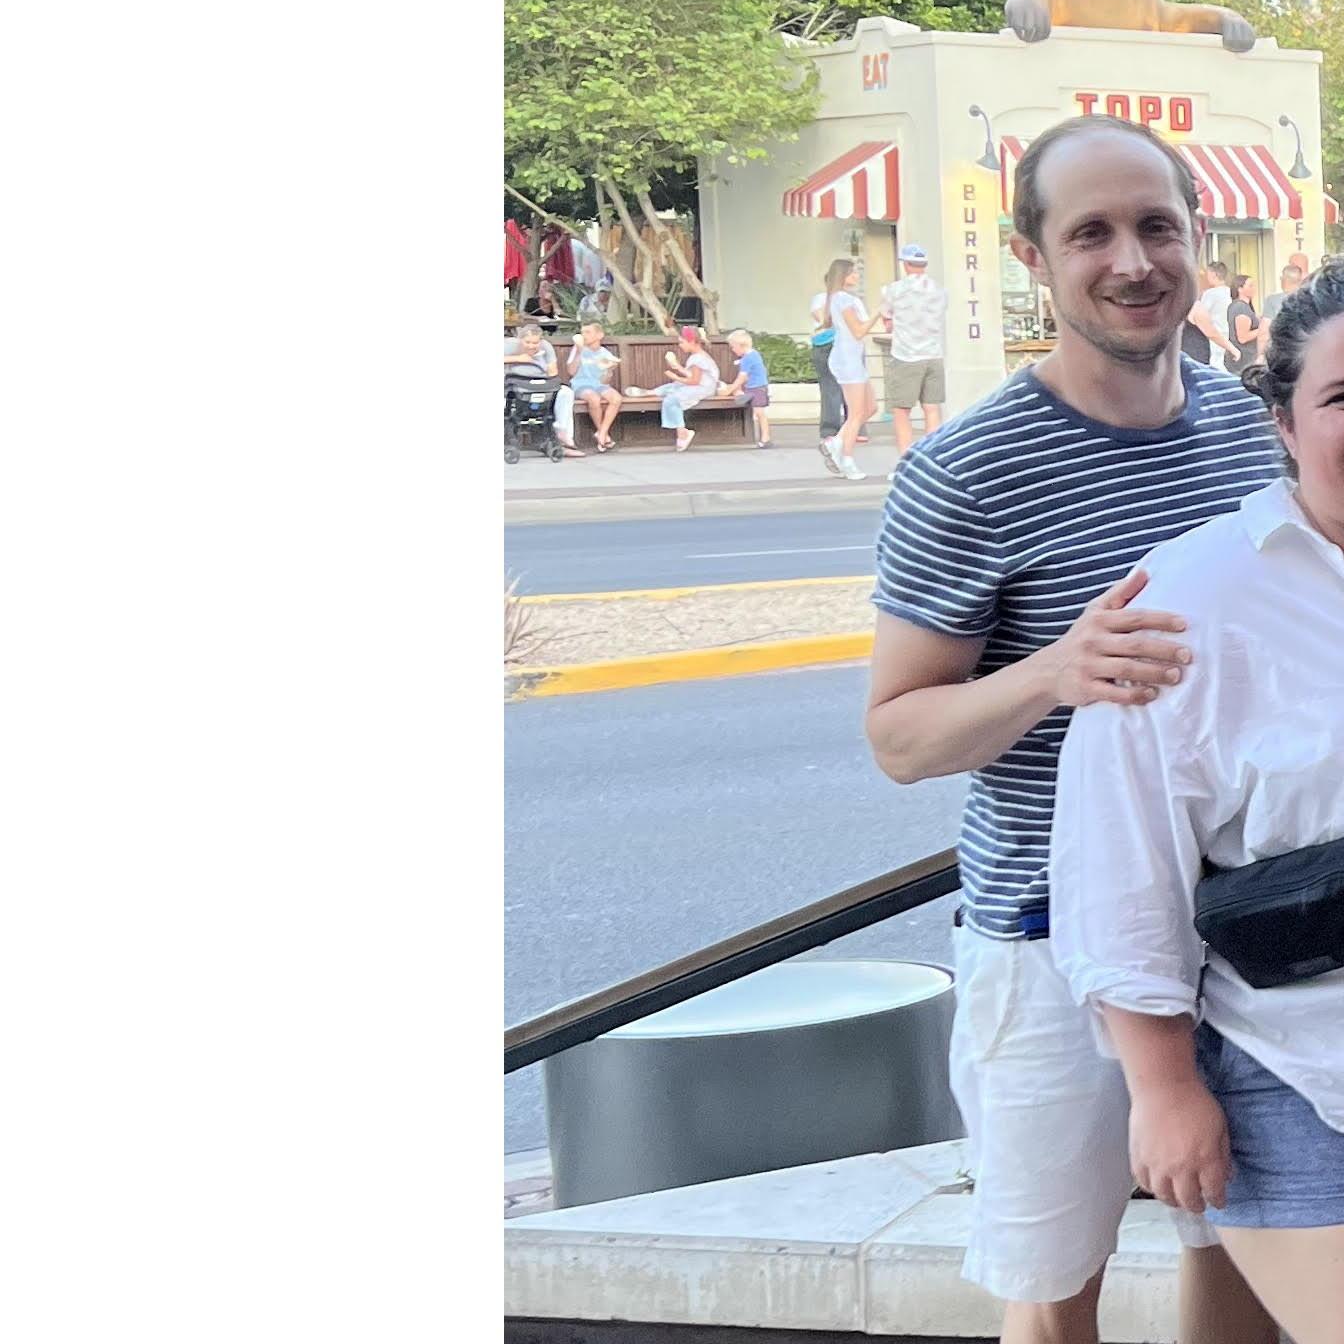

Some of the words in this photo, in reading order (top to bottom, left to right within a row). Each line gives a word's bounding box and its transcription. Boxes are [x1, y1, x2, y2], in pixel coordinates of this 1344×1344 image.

[862, 52, 889, 91] EAT
[1075, 93, 1193, 131] TOPO
[963, 183, 981, 339] BURRITO
